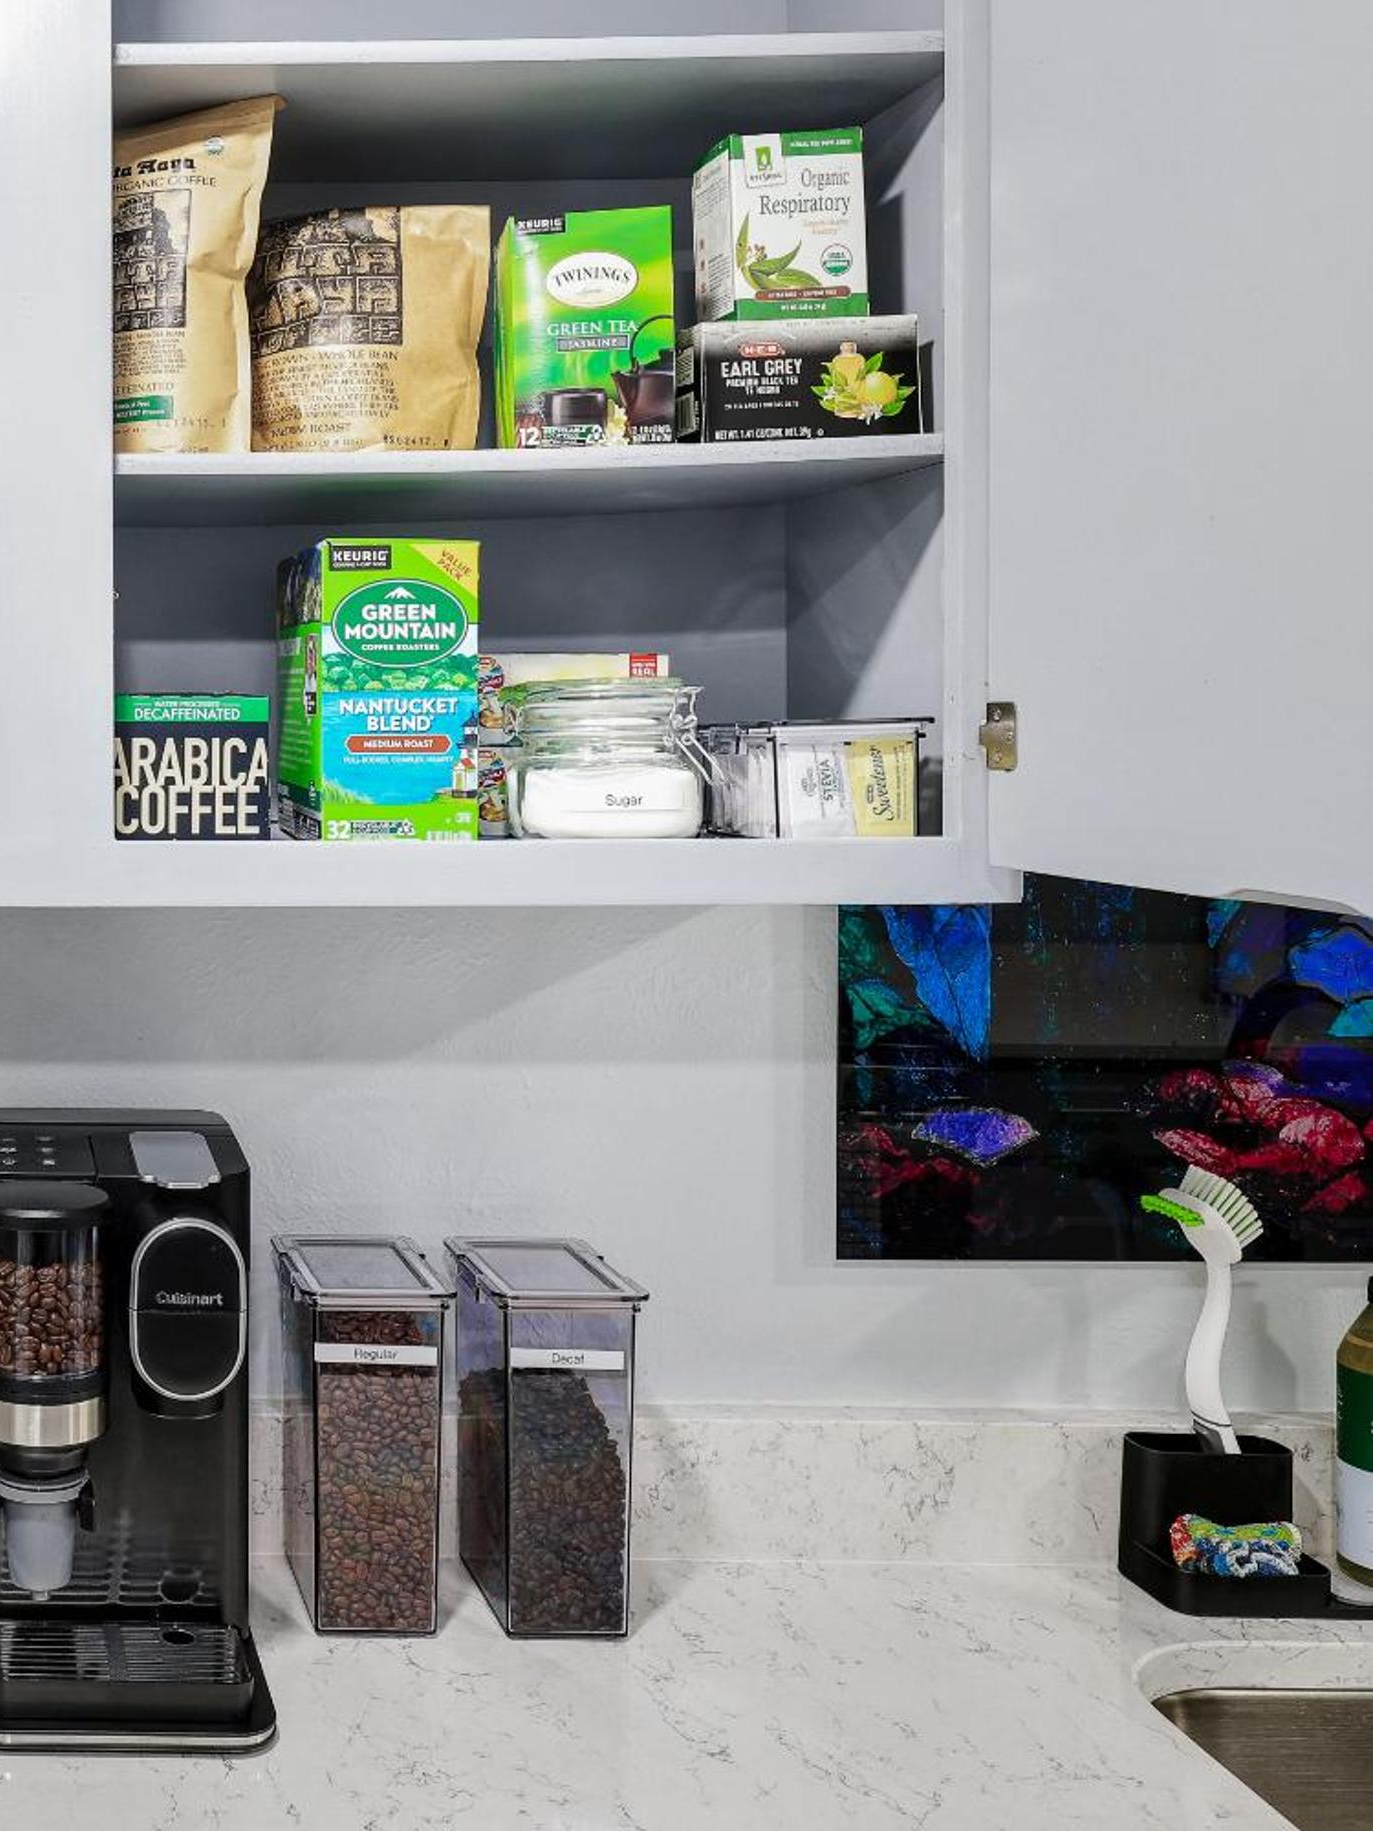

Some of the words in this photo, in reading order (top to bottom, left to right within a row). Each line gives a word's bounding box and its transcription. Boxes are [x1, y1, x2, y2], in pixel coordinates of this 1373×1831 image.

[113, 177, 164, 192] RGANIC
[167, 176, 217, 187] COFFEE
[801, 168, 850, 191] Organic
[759, 195, 852, 218] Respiratory
[518, 218, 562, 229] KEURIG
[553, 266, 632, 287] TWININGS
[547, 321, 602, 335] GREEN
[608, 320, 638, 332] TEA
[569, 338, 618, 348] JASMINE
[721, 361, 760, 377] EARL
[764, 358, 802, 376] GREY
[519, 427, 540, 446] 12
[333, 550, 387, 561] KEURIG
[442, 549, 471, 574] VALUE
[437, 558, 464, 581] PACK
[361, 603, 436, 620] GREEN
[344, 622, 456, 640] MOUNTAIN
[361, 643, 394, 651] COFFEE
[396, 643, 439, 651] ROASTERS
[134, 708, 241, 720] DECAFFEINATED
[339, 697, 458, 715] NANTUCKET
[367, 715, 432, 731] BLEND
[364, 739, 402, 748] MEDIUM
[404, 739, 434, 748] ROAST
[113, 737, 268, 786] ARABICA
[819, 759, 834, 801] STEVIA
[868, 745, 894, 820] Sweetener
[116, 785, 260, 834] COFFEE
[605, 794, 644, 809] Sugar
[328, 820, 351, 840] 32
[156, 1291, 223, 1306] Cuisinart
[354, 1349, 398, 1362] Regular
[552, 1352, 585, 1364] Decaf
